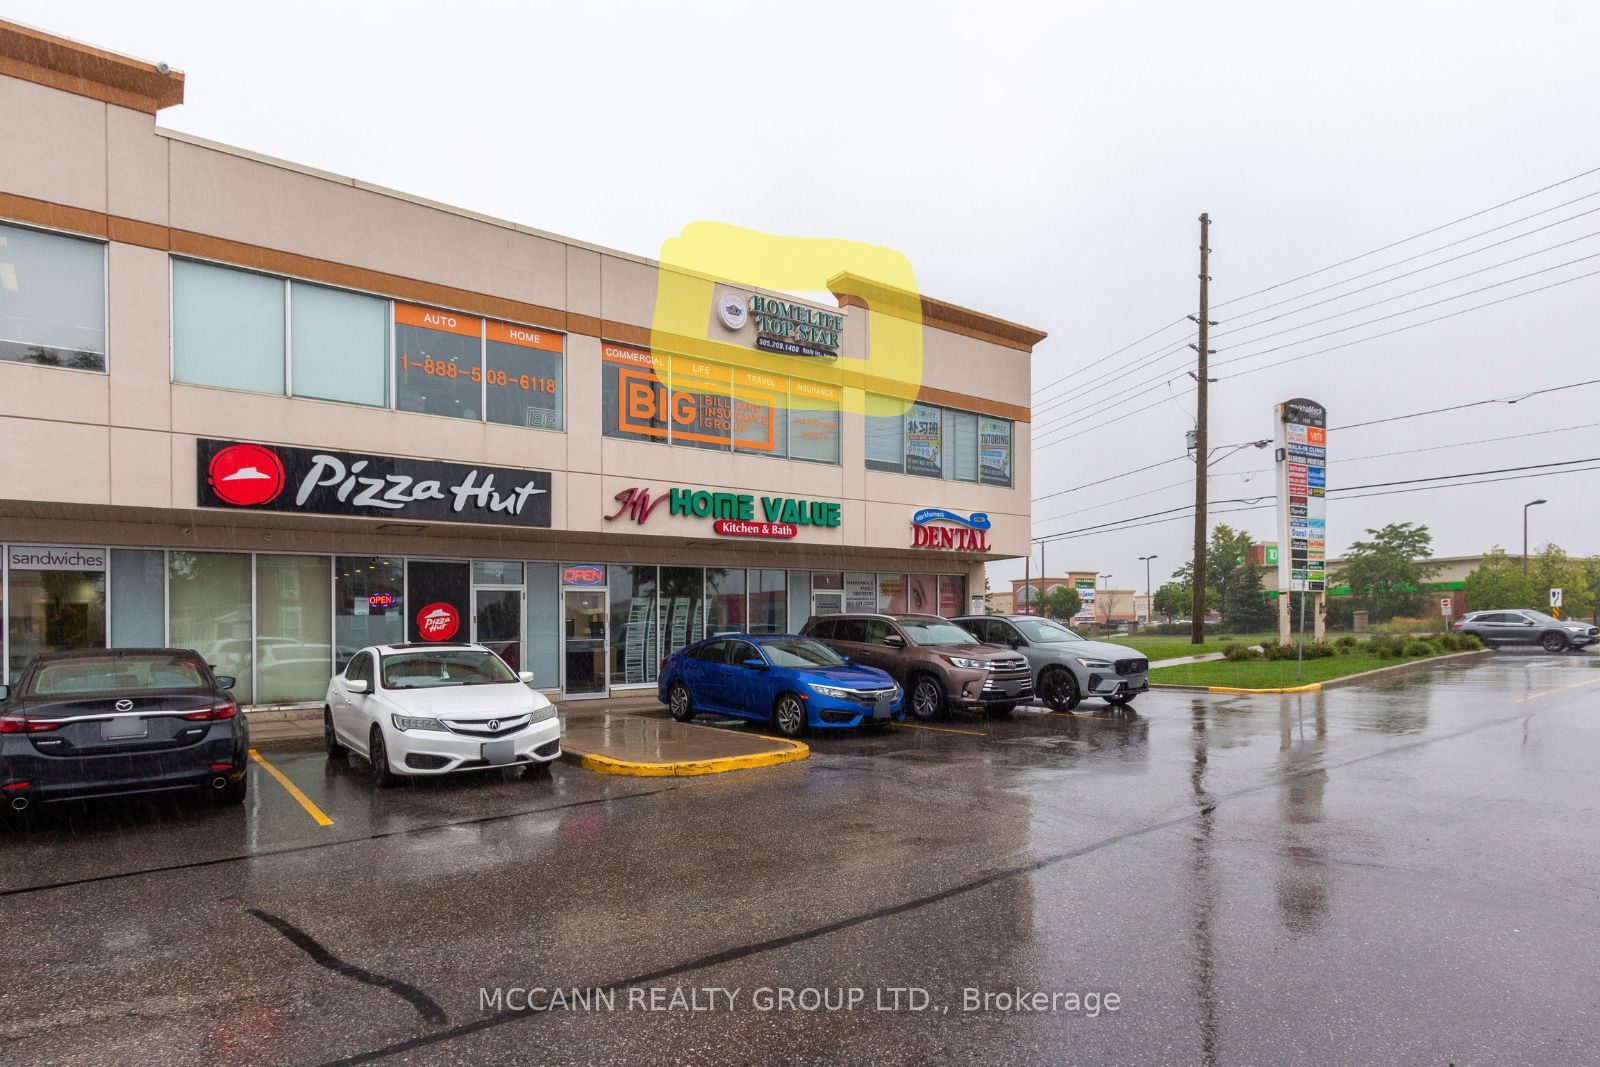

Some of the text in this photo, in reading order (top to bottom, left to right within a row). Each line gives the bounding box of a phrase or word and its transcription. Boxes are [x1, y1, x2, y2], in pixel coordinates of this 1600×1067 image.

[750, 295, 843, 331] HOMELIFE
[424, 313, 457, 328] AUTO
[510, 329, 540, 344] HOME
[758, 315, 840, 348] TOP STAR
[605, 347, 665, 366] COMMERCIAL
[692, 363, 710, 374] LIFE
[746, 374, 776, 387] TRAVEL
[795, 383, 834, 397] INSURANCE
[629, 382, 696, 425] BIG
[908, 421, 939, 435] 补习班
[980, 433, 1009, 446] TUTORING
[296, 454, 547, 514] Pizza Hut
[669, 487, 841, 527] HOME VALUE
[722, 522, 792, 536] Kitchen & Bath
[912, 524, 992, 552] DENTAL
[12, 550, 103, 567] sandwiches
[563, 568, 604, 582] OPEN
[369, 595, 392, 605] OPEN
[424, 617, 451, 629] Pizza
[429, 623, 448, 633] Hut
